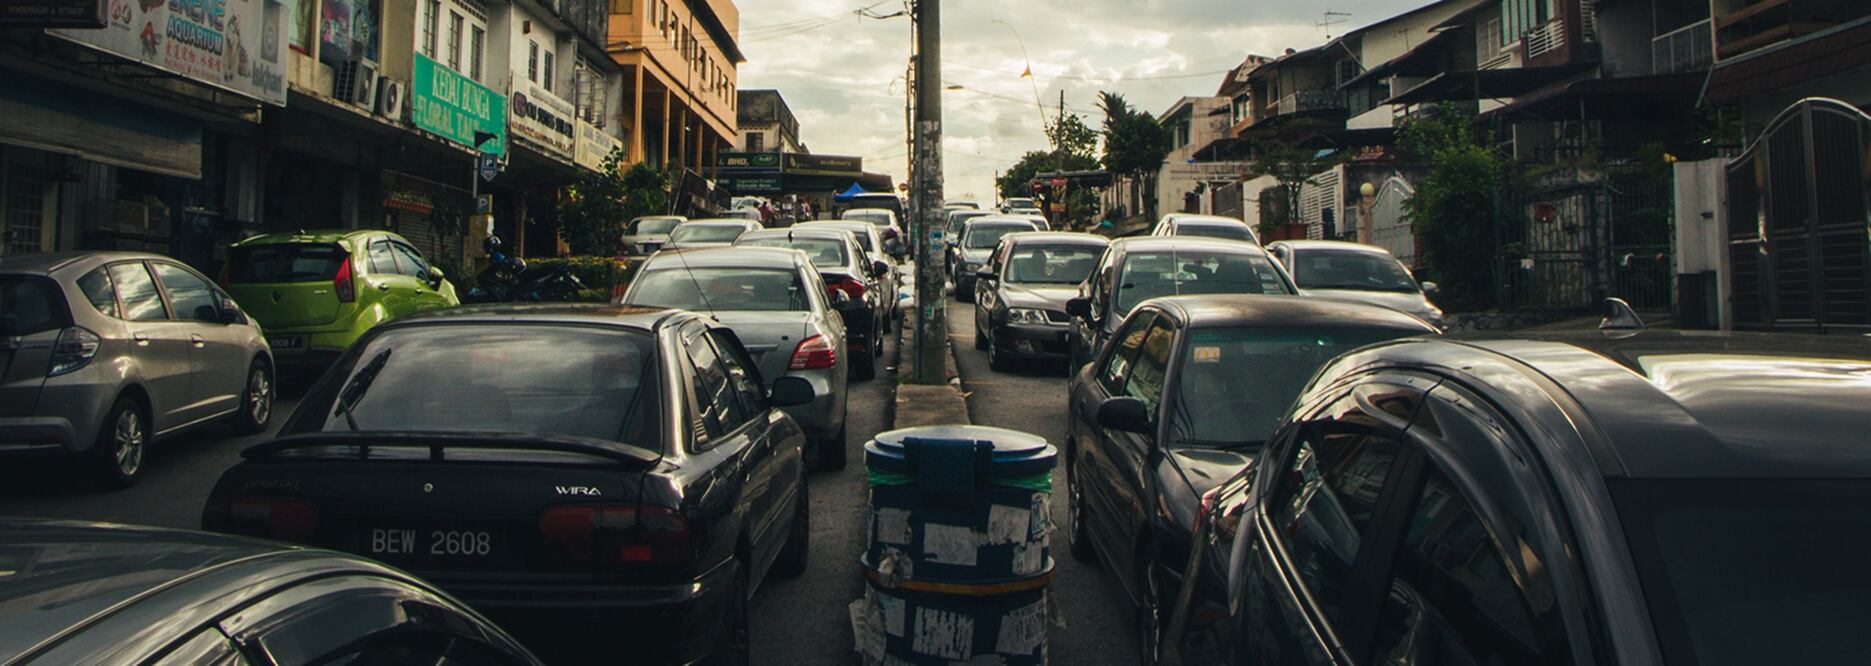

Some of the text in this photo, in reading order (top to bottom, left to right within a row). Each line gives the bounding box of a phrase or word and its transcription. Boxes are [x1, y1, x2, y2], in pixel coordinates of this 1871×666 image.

[167, 15, 224, 56] AQUARIUM
[432, 65, 461, 108] KEDAI
[462, 81, 490, 121] BUNGA
[416, 94, 454, 135] FLORAL
[486, 159, 493, 167] P
[479, 198, 488, 208] P
[555, 485, 602, 497] WIRA
[372, 529, 491, 556] BEW 2608
